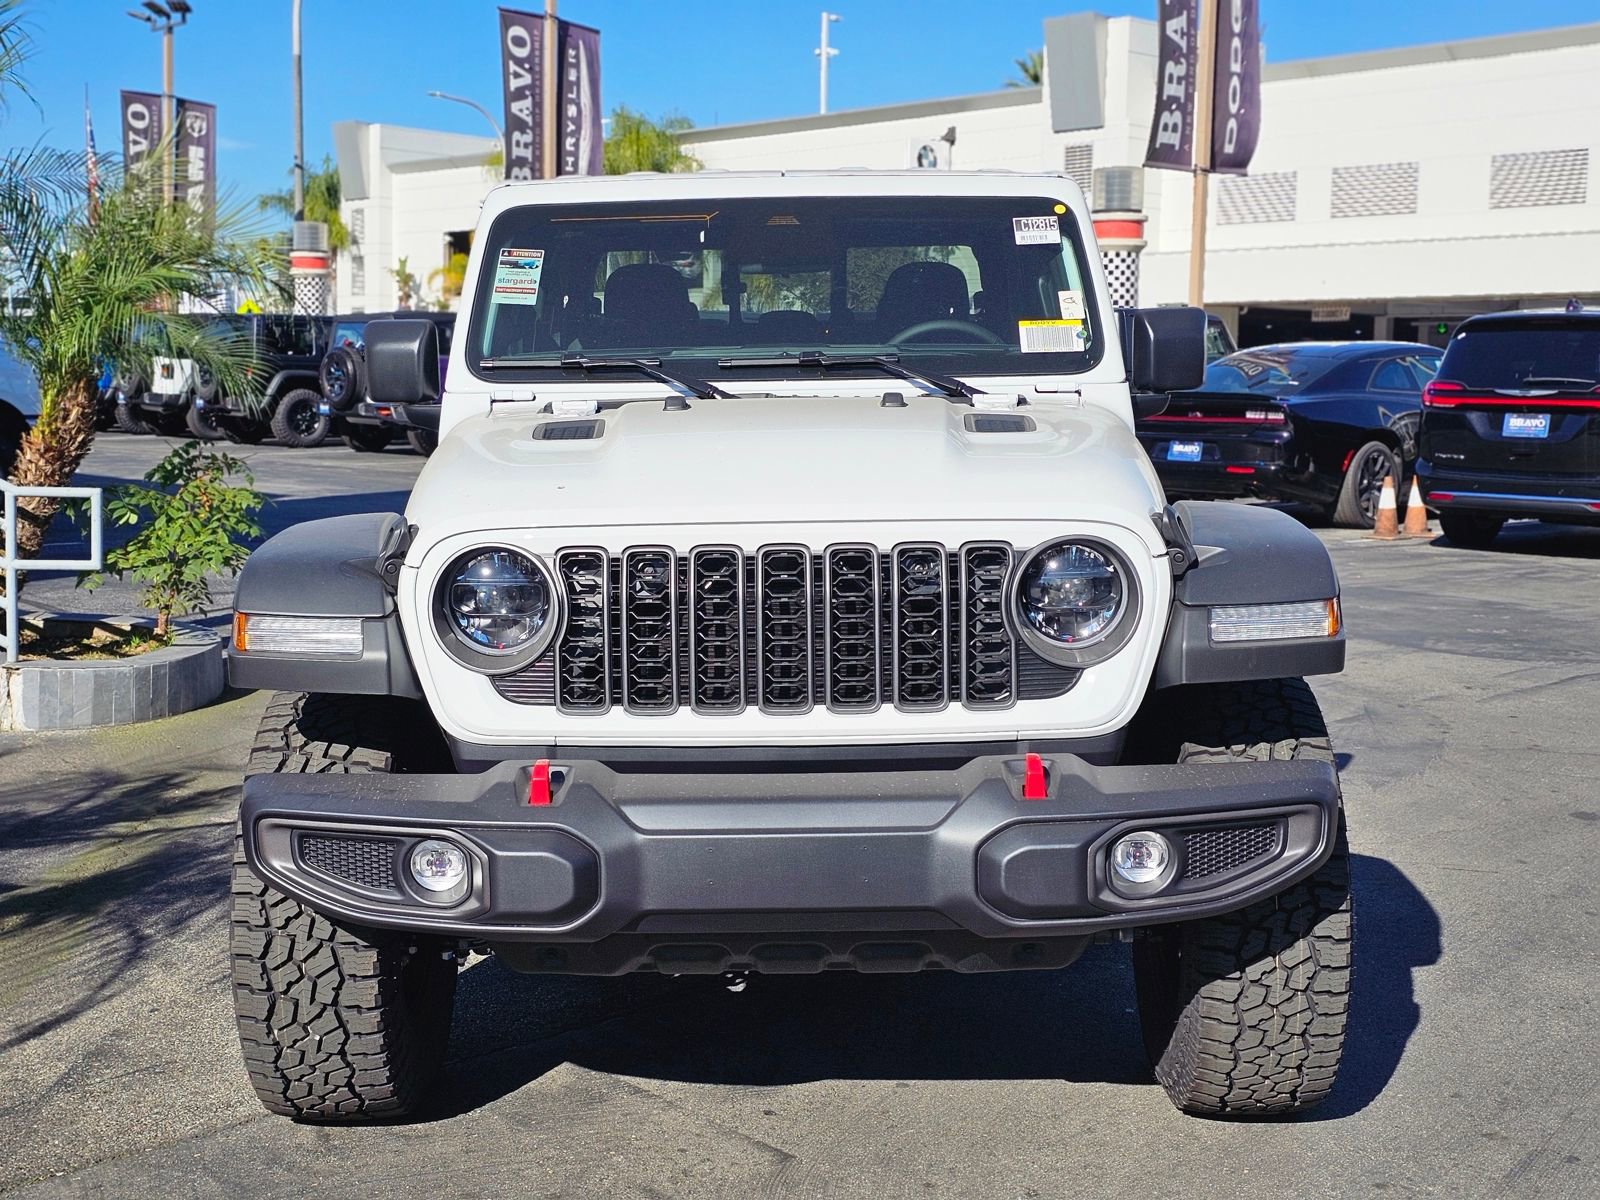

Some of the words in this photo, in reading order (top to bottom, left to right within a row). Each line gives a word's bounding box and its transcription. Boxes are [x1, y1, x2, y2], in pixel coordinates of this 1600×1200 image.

[1155, 0, 1187, 150] BRA
[1223, 0, 1242, 154] DODG
[565, 48, 578, 172] HRYSLER
[1021, 218, 1058, 231] C12815
[512, 250, 542, 258] ATTENTION
[1509, 418, 1546, 427] BRAVO
[1172, 444, 1200, 453] BRAVO
